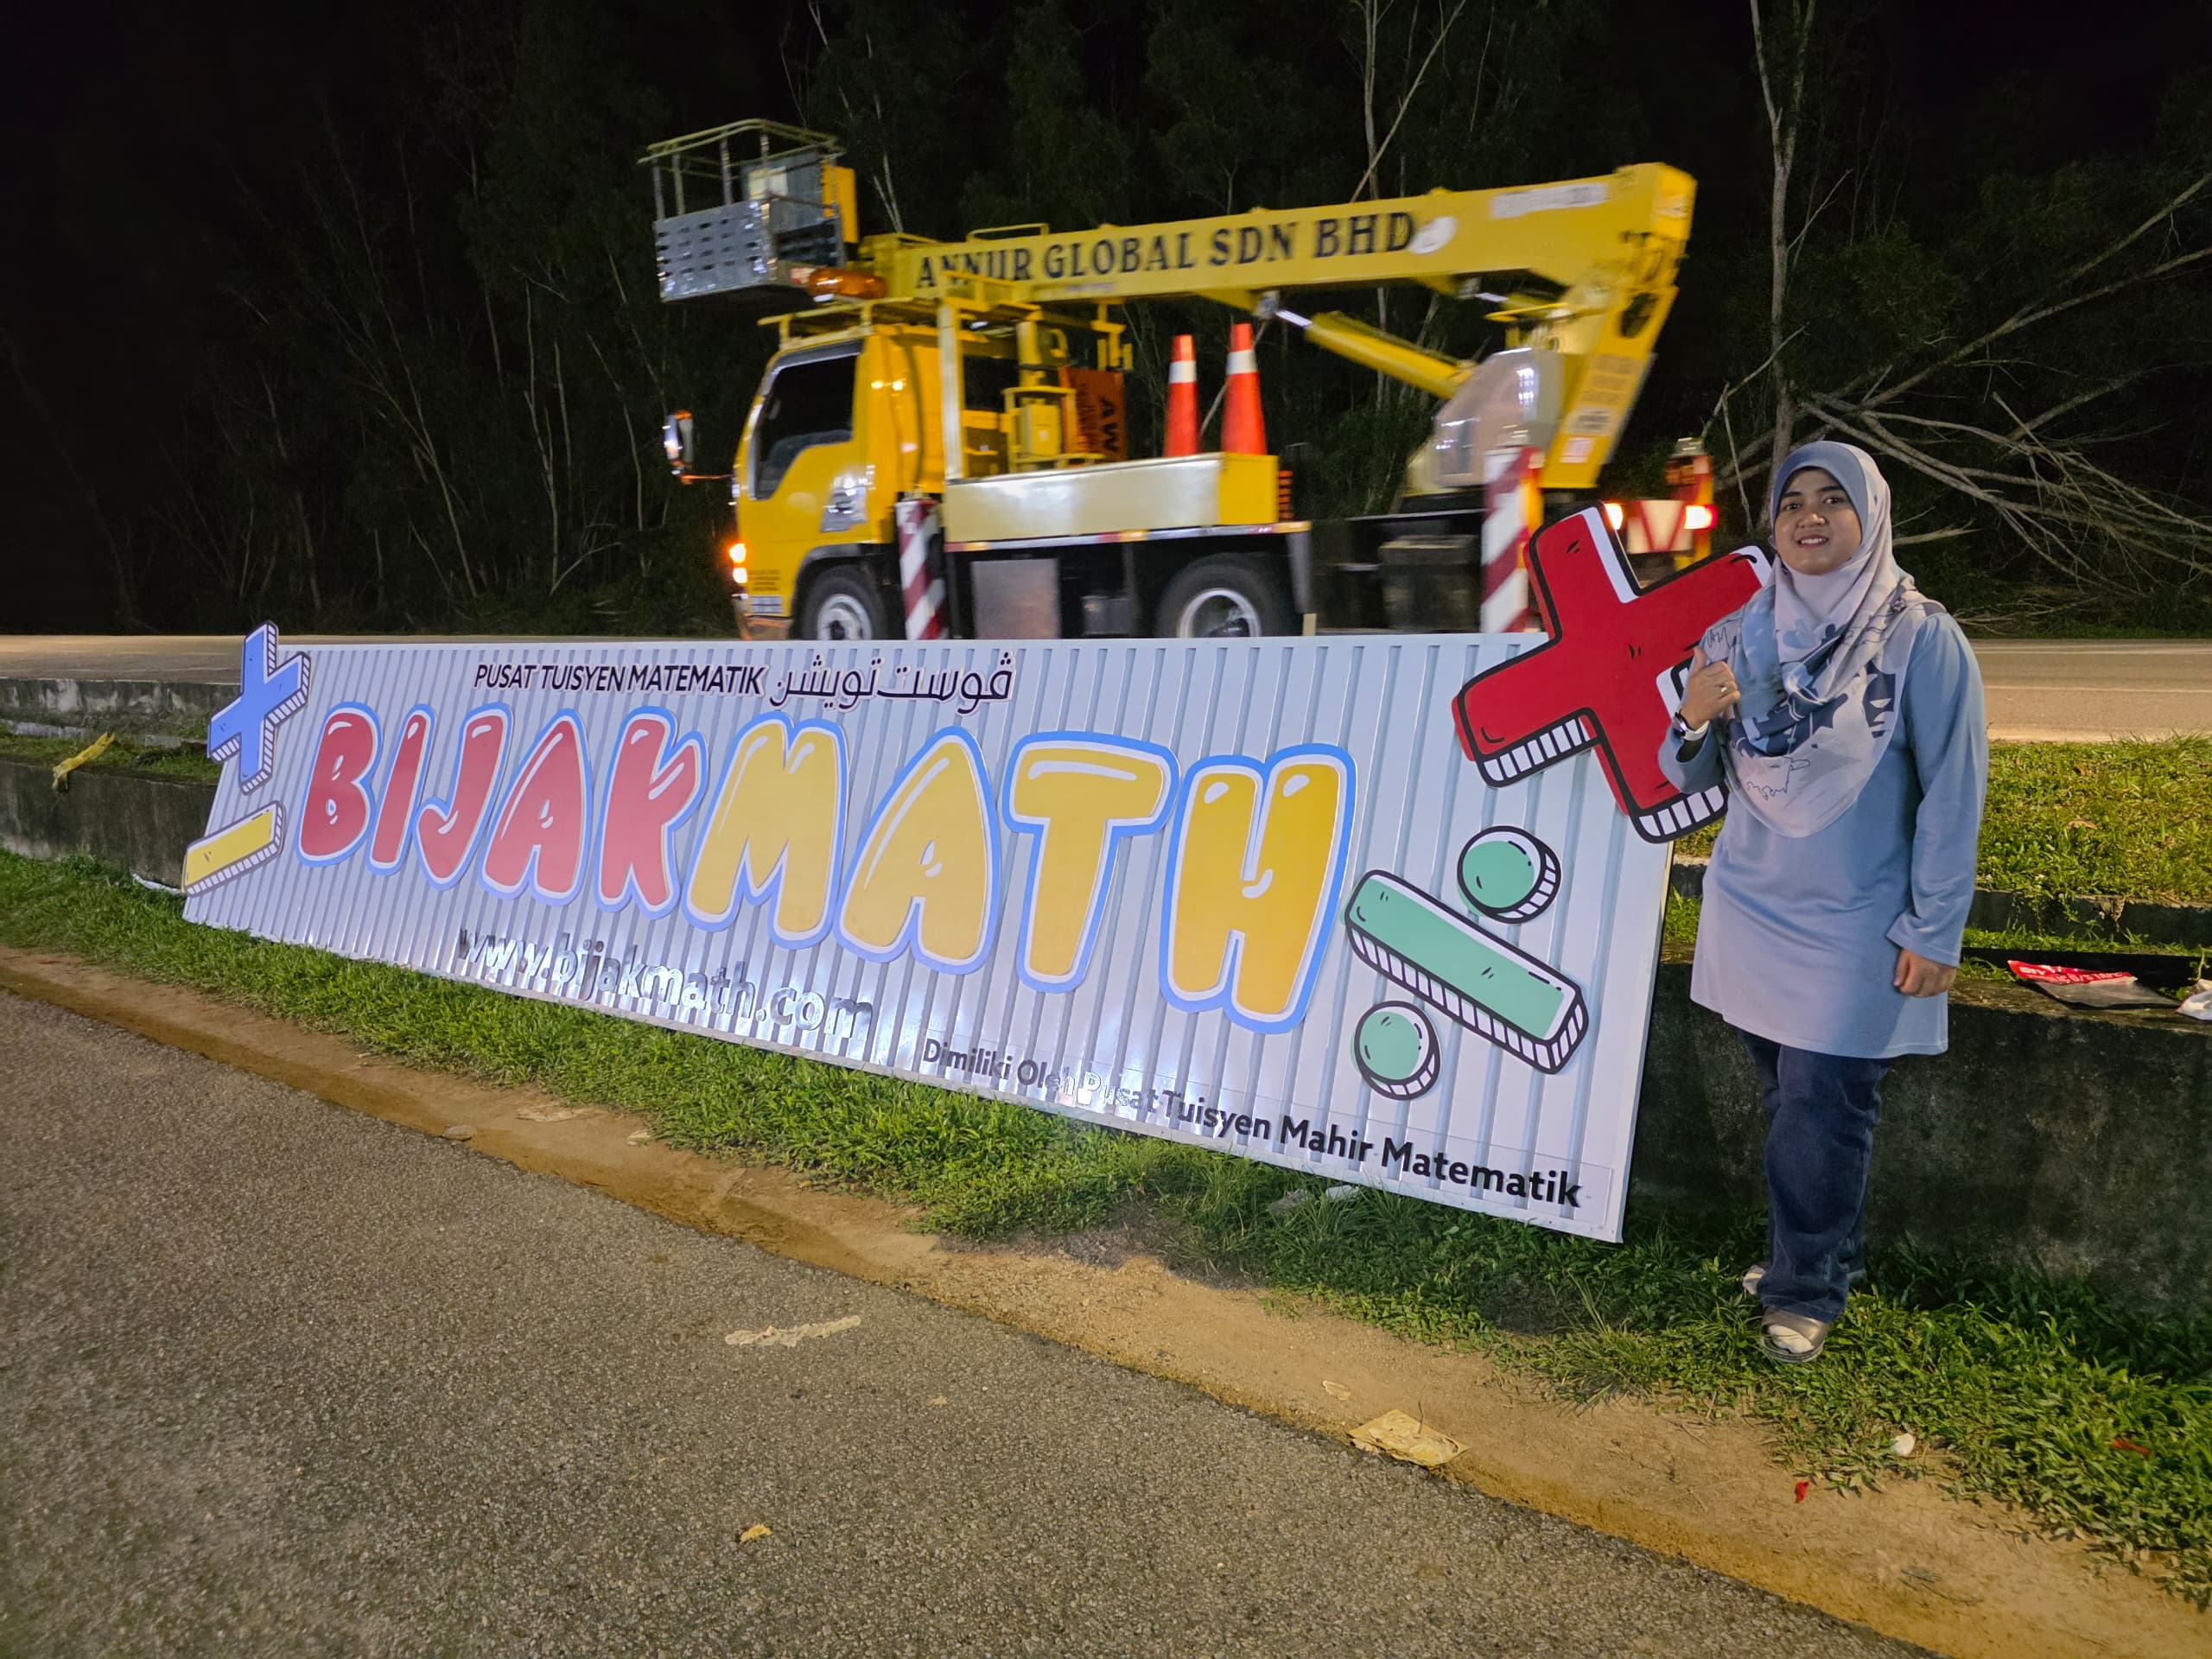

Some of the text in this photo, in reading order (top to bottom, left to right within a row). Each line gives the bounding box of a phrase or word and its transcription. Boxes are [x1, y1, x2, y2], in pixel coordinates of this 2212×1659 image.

[1044, 231, 1194, 279] GLOBAL
[1209, 222, 1297, 268] SDN
[1313, 211, 1416, 258] BHD
[474, 664, 766, 695] PUSAT TUISYEN MATEMATIK
[458, 927, 874, 1039] www.bijakmath.com
[922, 1038, 1013, 1080] Dimiliki
[1017, 1059, 1077, 1096] Oleh
[1162, 1089, 1270, 1140] Tuisyen
[1280, 1115, 1374, 1162] Mahir
[1381, 1136, 1582, 1208] Matematik
